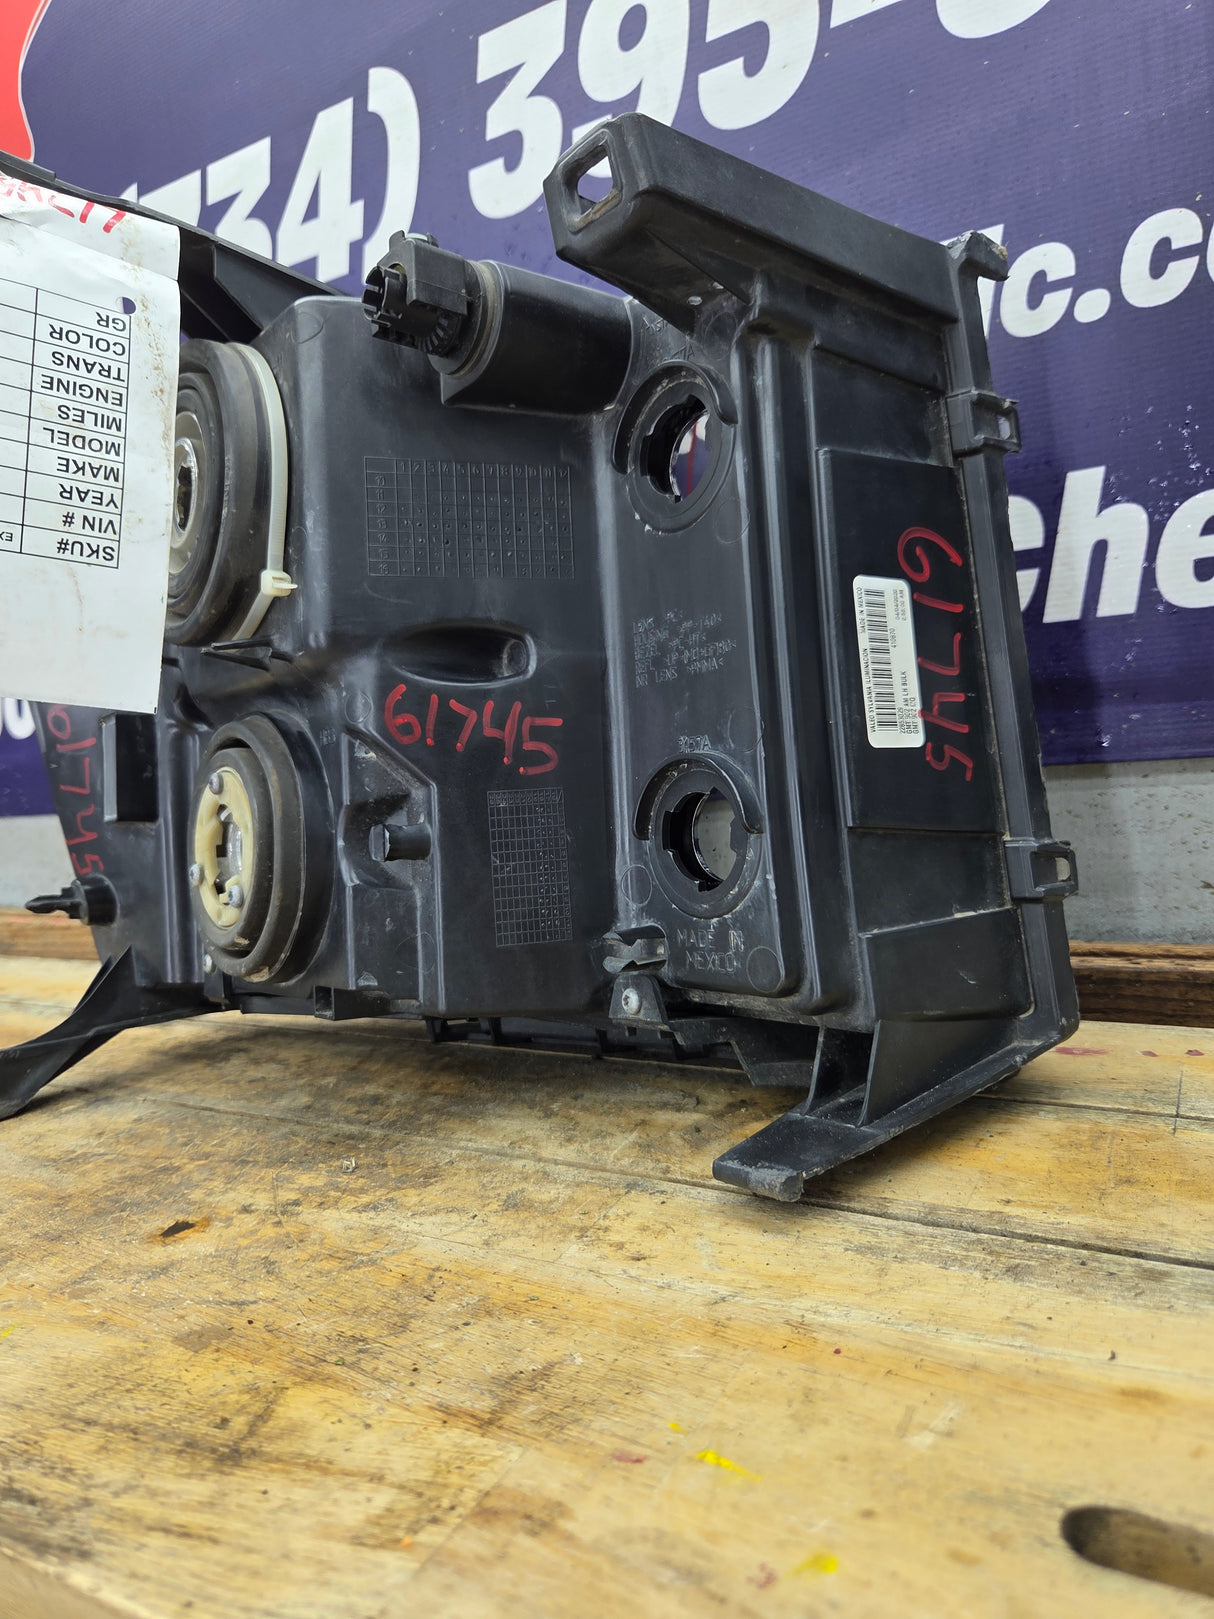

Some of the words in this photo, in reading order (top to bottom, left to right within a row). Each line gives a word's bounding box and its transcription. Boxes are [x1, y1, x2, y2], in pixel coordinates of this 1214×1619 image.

[95, 311, 127, 332] GR
[49, 323, 126, 356] COLOR
[51, 351, 126, 382] TRANS
[40, 374, 123, 407] ENGINE
[57, 404, 122, 432] MILES
[43, 427, 121, 457] MODEL
[56, 456, 120, 483] MAKE
[58, 483, 119, 509] YEAR
[62, 511, 75, 527] #
[82, 515, 117, 535] VIN
[57, 538, 116, 561] SKU#
[856, 587, 864, 609] MEXICO
[897, 527, 974, 782] 61745
[655, 666, 678, 683] LENS
[900, 671, 908, 686] BULK
[867, 685, 875, 713] SYLVANIA
[385, 684, 564, 775] 61745
[905, 720, 913, 734] GMT
[911, 720, 919, 734] GMT
[677, 929, 716, 948] MADE
[729, 930, 745, 952] IN
[685, 950, 737, 974] MEXICO
